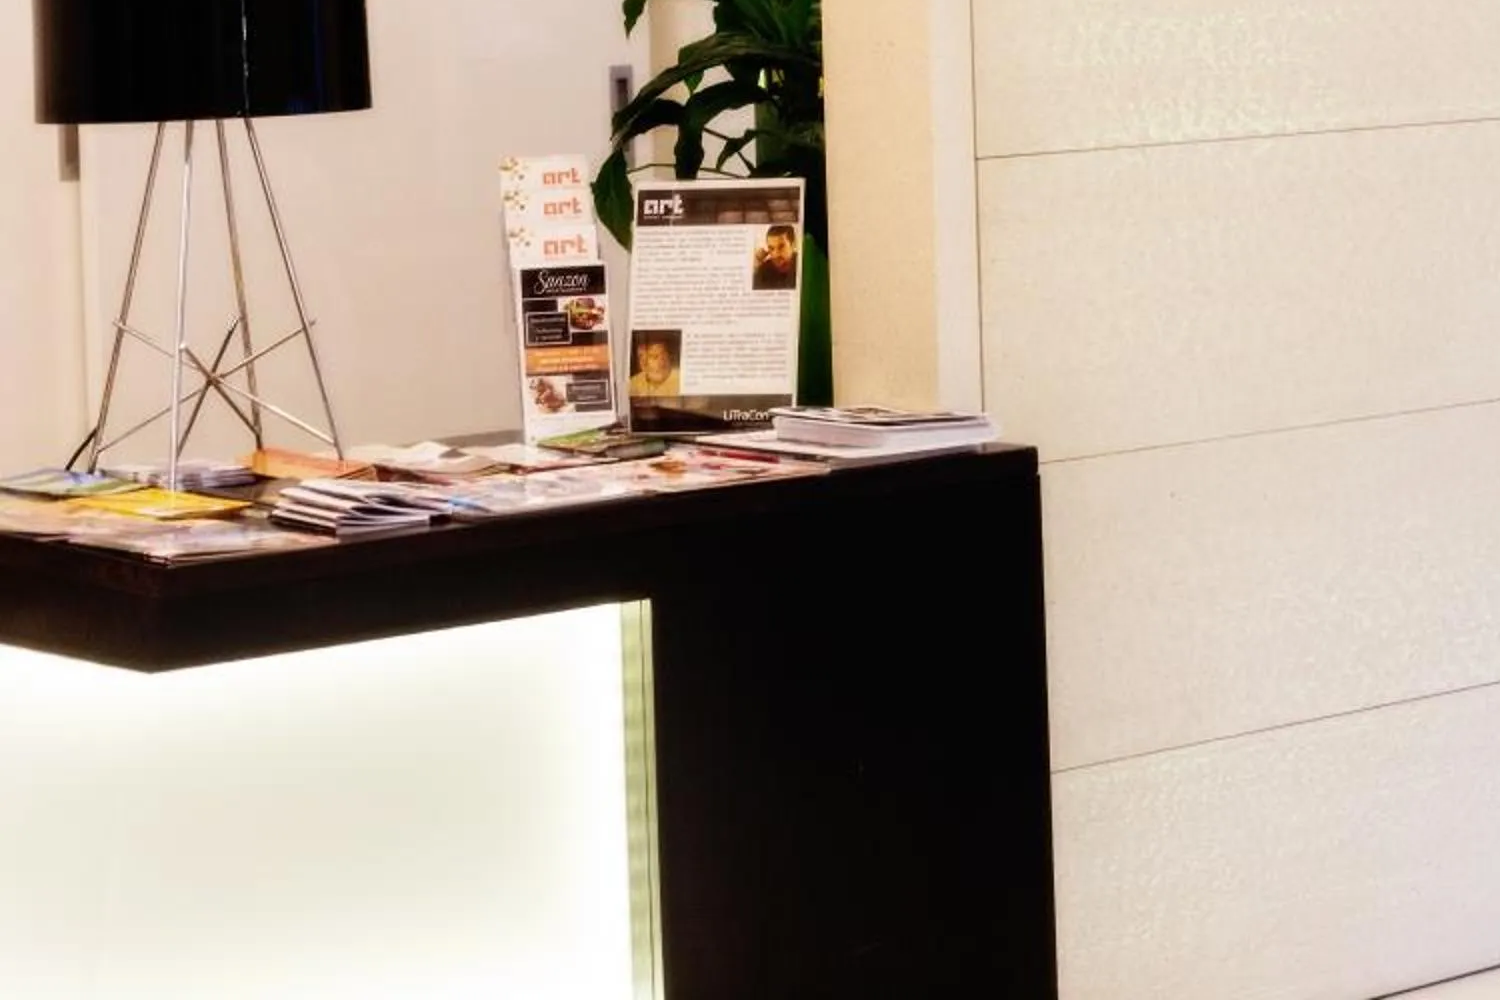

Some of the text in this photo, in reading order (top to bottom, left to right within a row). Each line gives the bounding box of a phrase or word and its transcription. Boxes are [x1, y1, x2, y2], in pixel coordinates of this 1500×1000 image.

[543, 167, 581, 184] art
[543, 197, 582, 214] art
[643, 194, 684, 215] art
[543, 234, 588, 255] art
